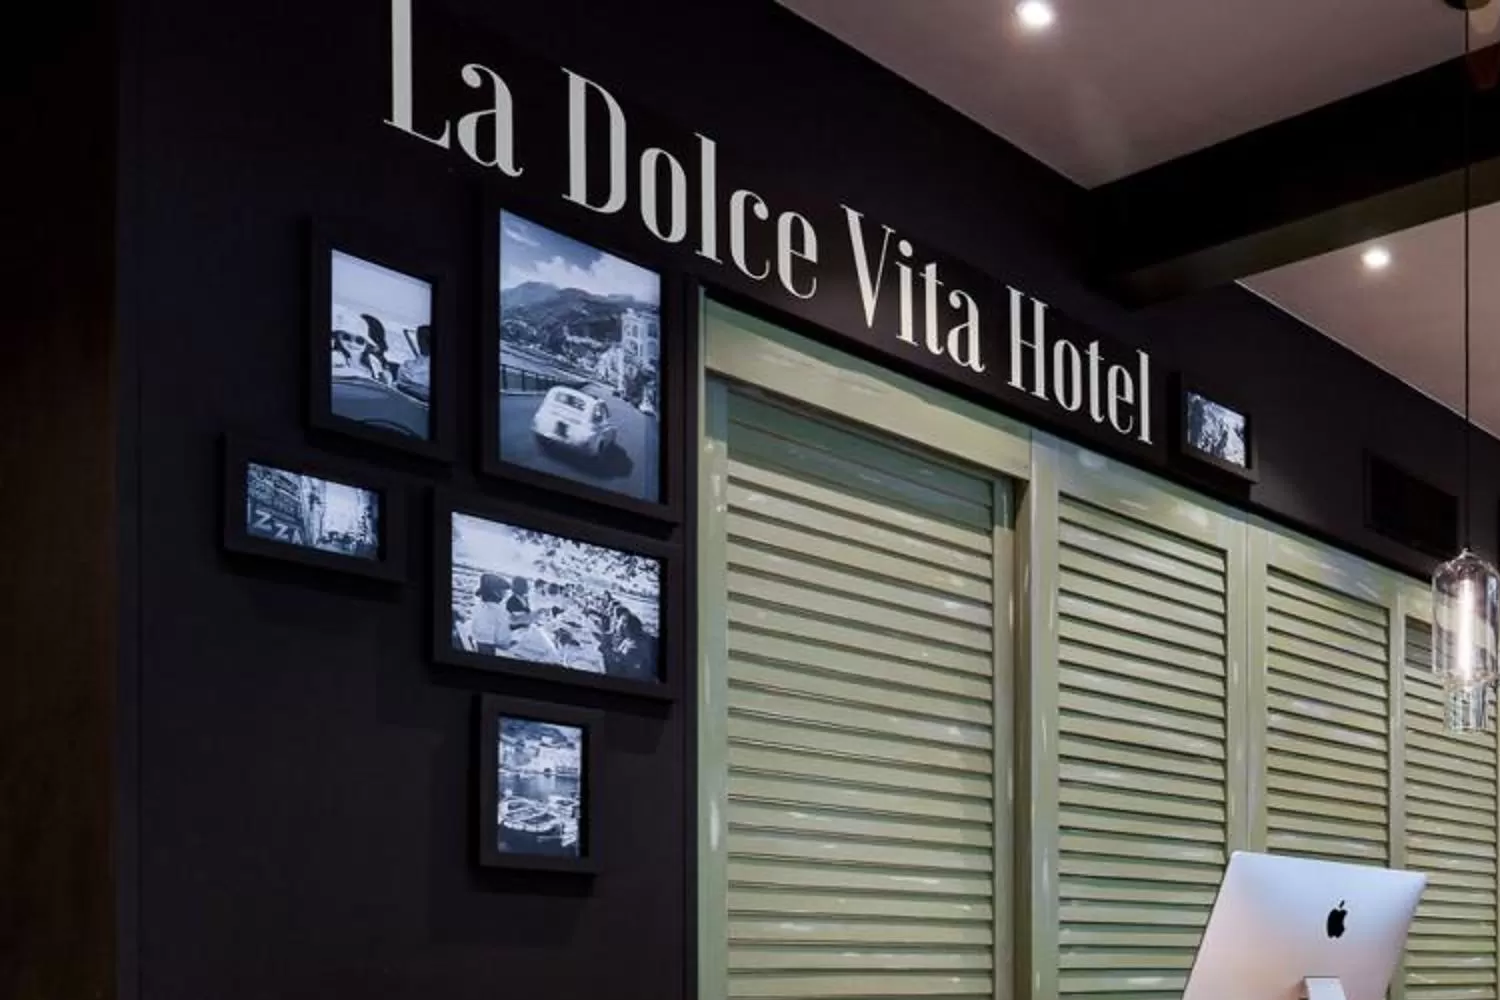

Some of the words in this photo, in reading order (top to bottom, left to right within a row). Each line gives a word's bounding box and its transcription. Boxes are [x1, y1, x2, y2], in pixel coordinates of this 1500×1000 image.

[383, 0, 524, 178] La
[561, 67, 819, 300] Dolce
[840, 203, 987, 374] Vita
[1006, 285, 1153, 445] Hotel
